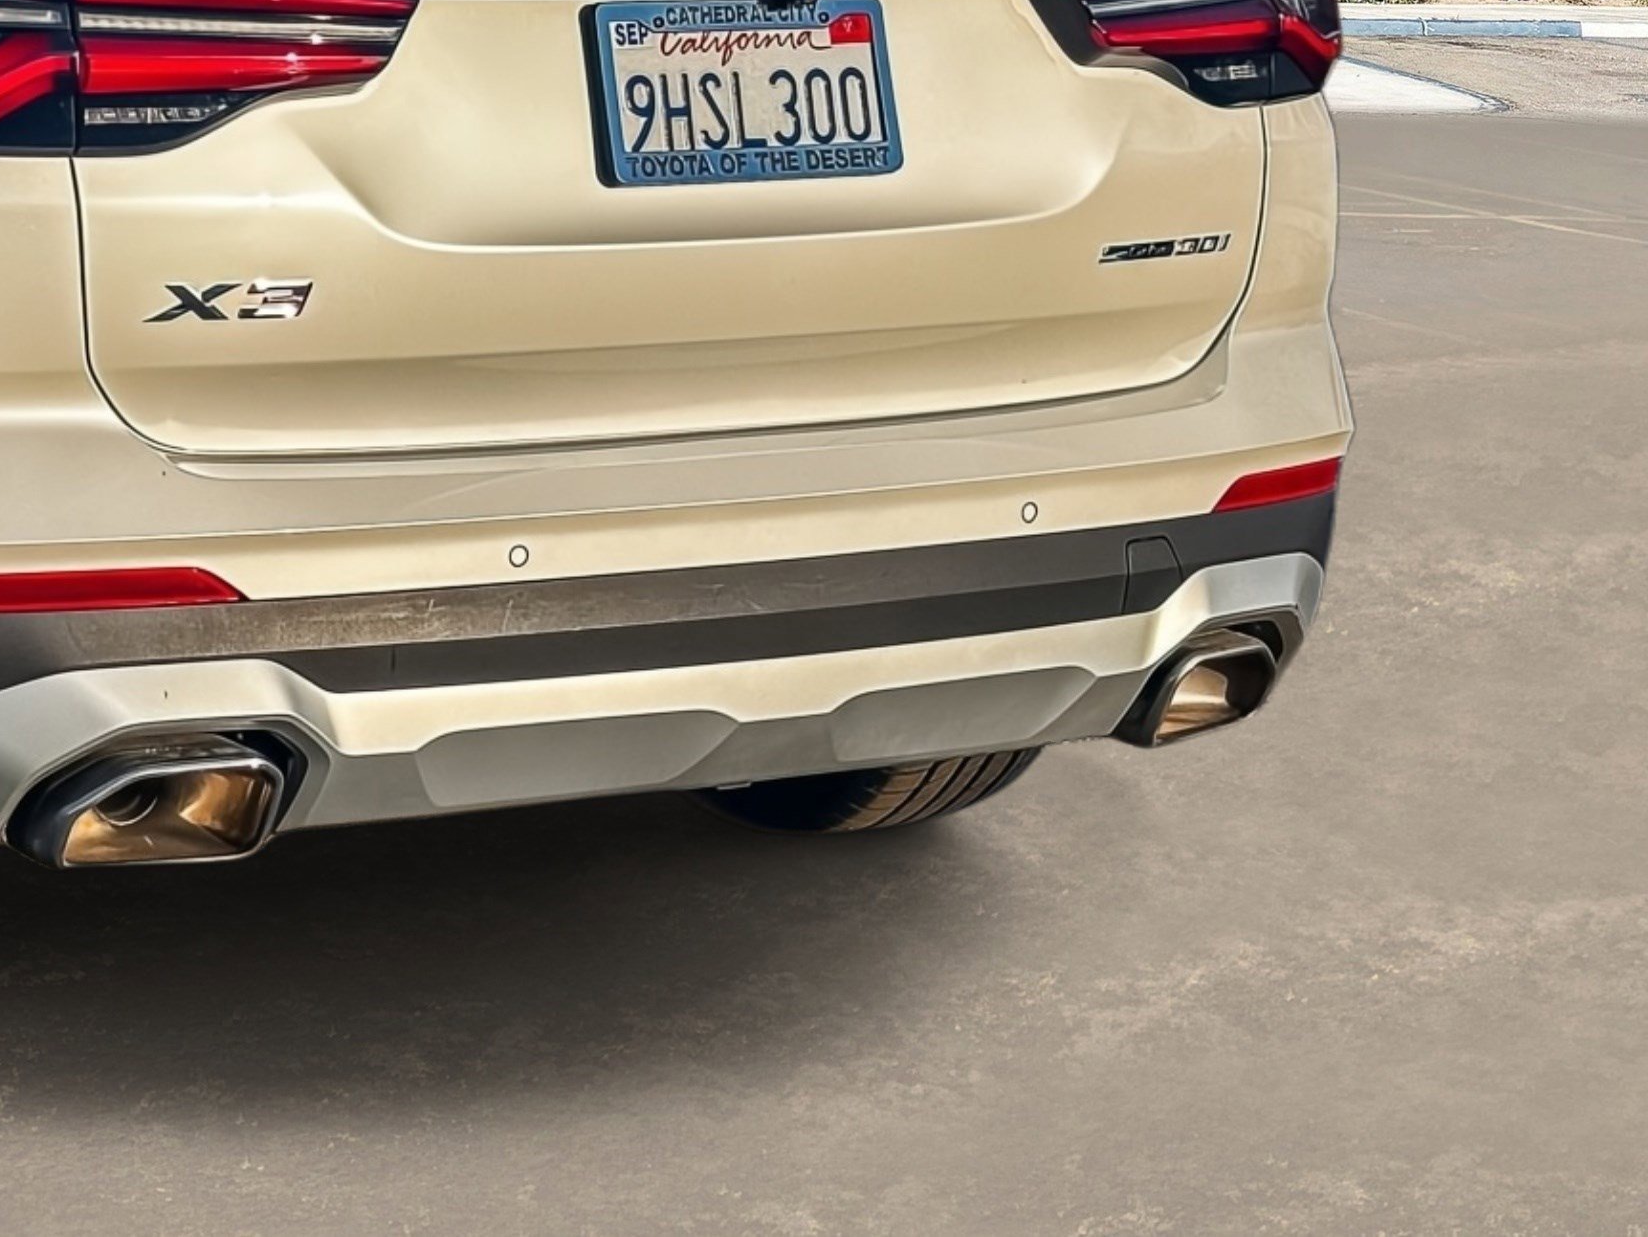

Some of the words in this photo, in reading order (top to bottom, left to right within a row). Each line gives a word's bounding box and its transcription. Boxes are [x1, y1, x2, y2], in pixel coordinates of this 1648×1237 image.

[665, 6, 772, 26] CATHEDRAL
[615, 23, 648, 46] SEP
[660, 30, 831, 66] California
[624, 66, 872, 153] 9HSL300
[625, 155, 712, 178] TOYOTA
[721, 153, 747, 174] OF
[754, 151, 800, 172] THE
[807, 146, 890, 170] DESERT
[142, 278, 313, 322] X3
